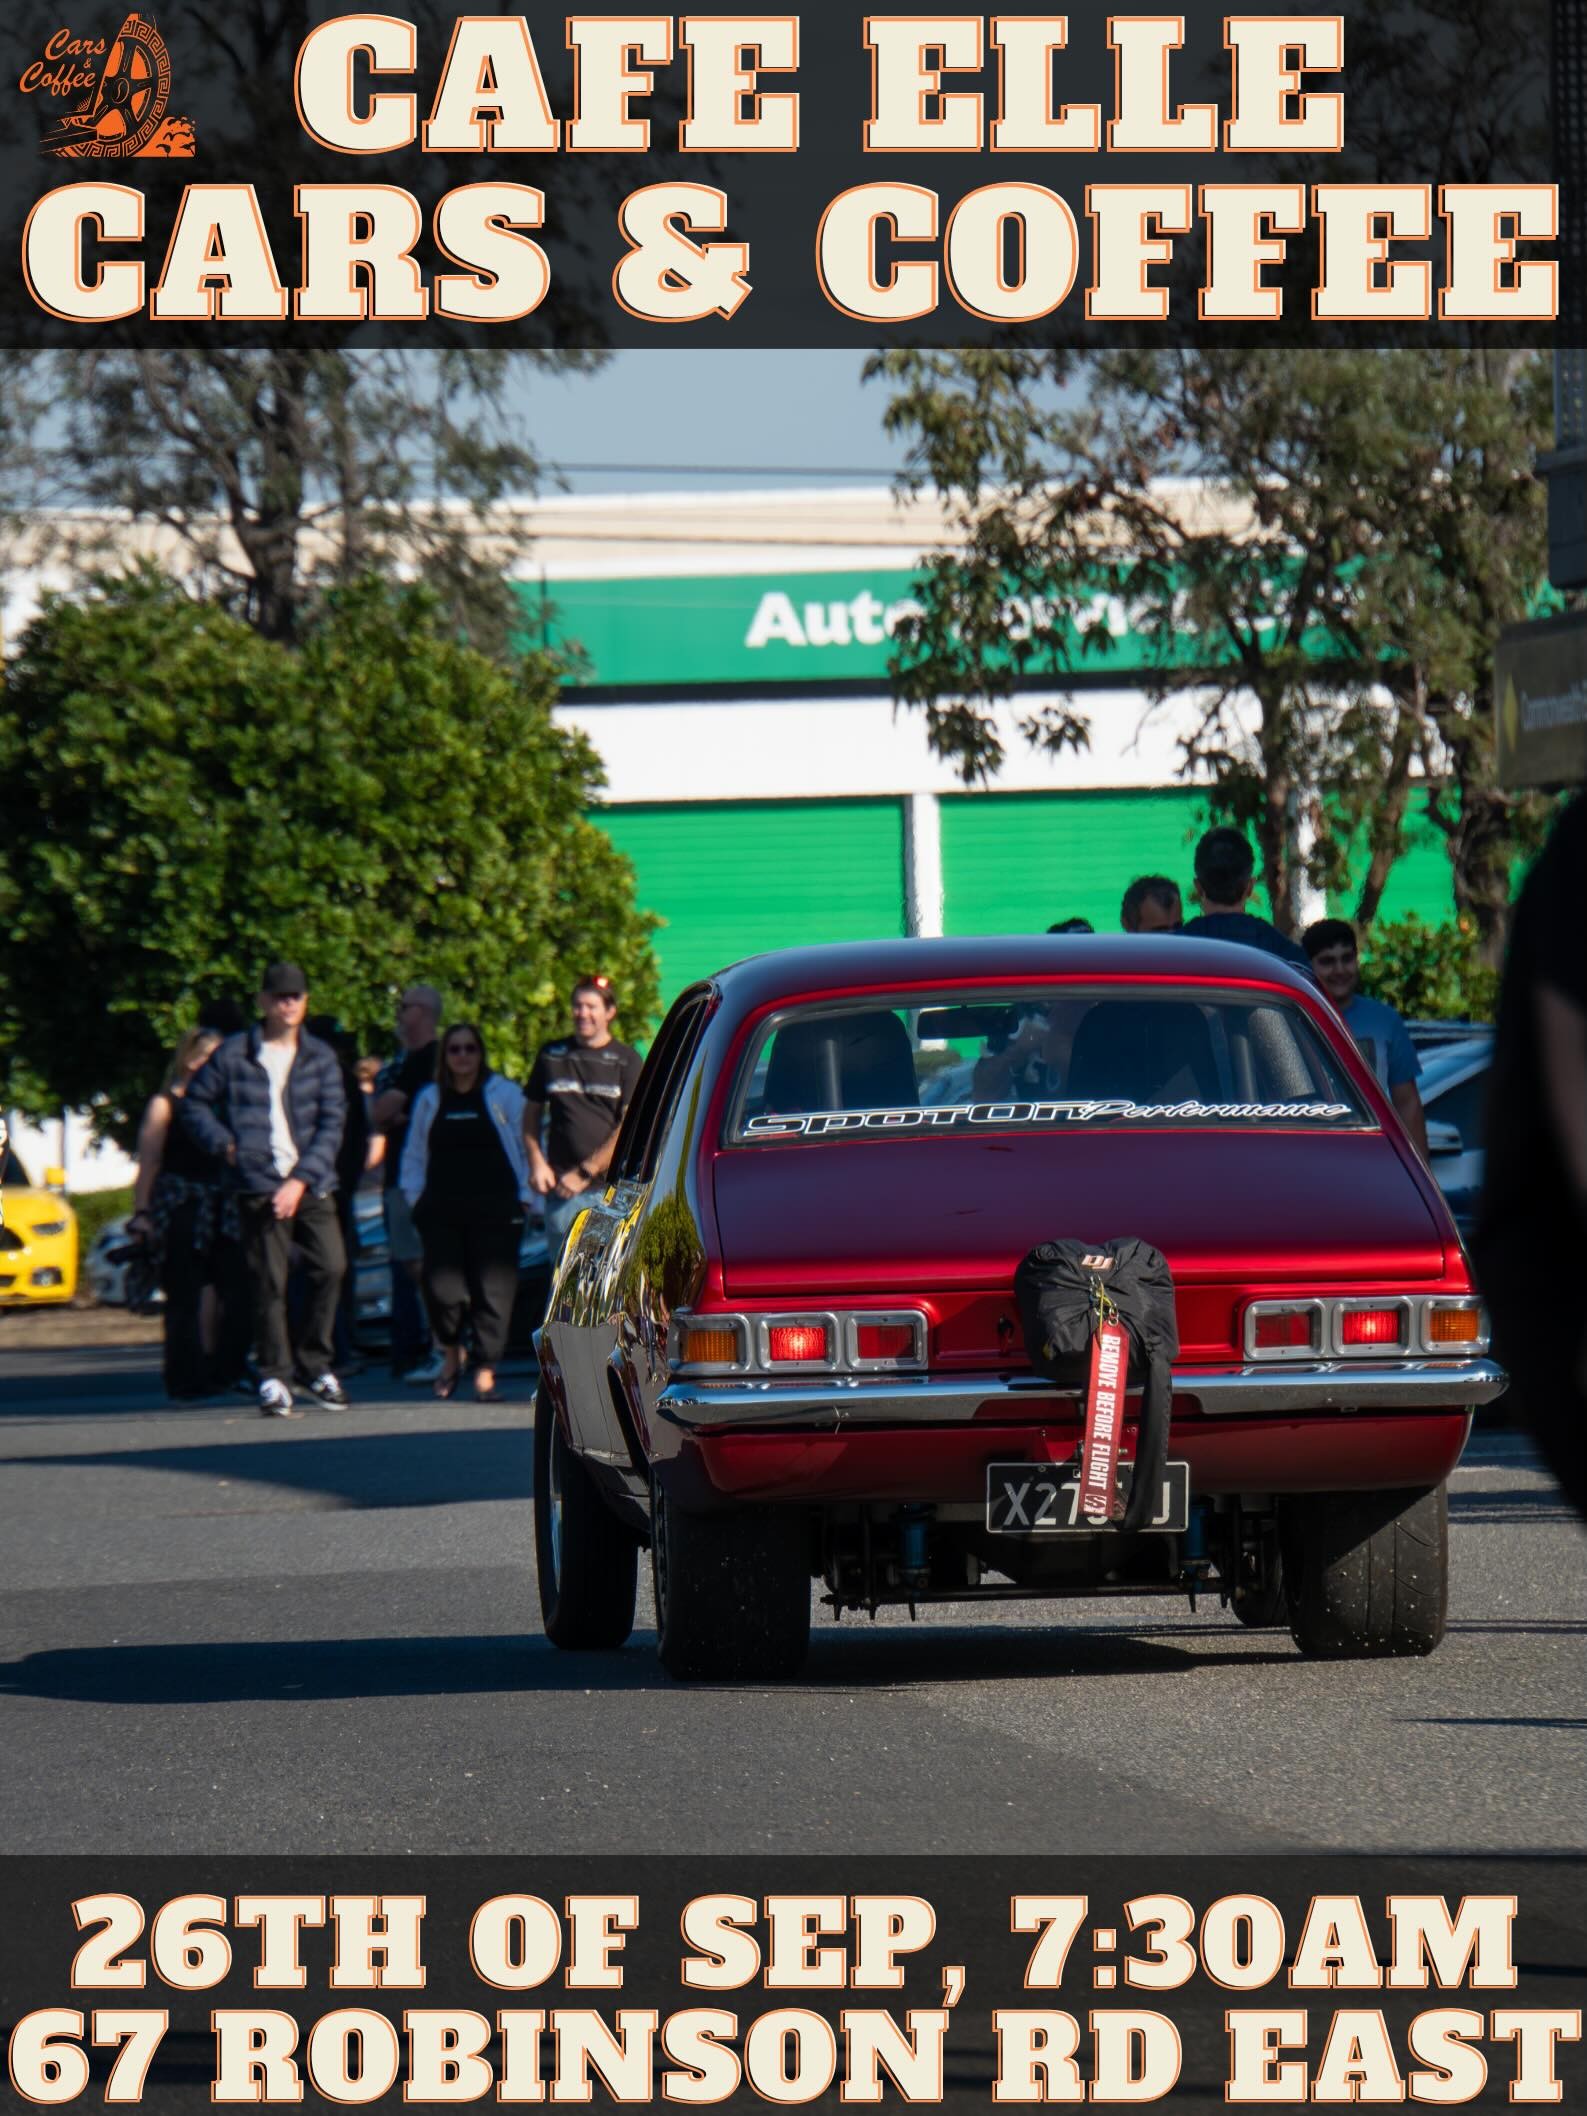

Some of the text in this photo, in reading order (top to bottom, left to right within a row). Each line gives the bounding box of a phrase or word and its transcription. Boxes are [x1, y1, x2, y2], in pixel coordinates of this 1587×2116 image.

[1097, 1334, 1121, 1390] REMOVE
[1093, 1391, 1116, 1441] BEFORE
[1088, 1443, 1111, 1491] FLIGHT
[1003, 1481, 1171, 1526] X27J
